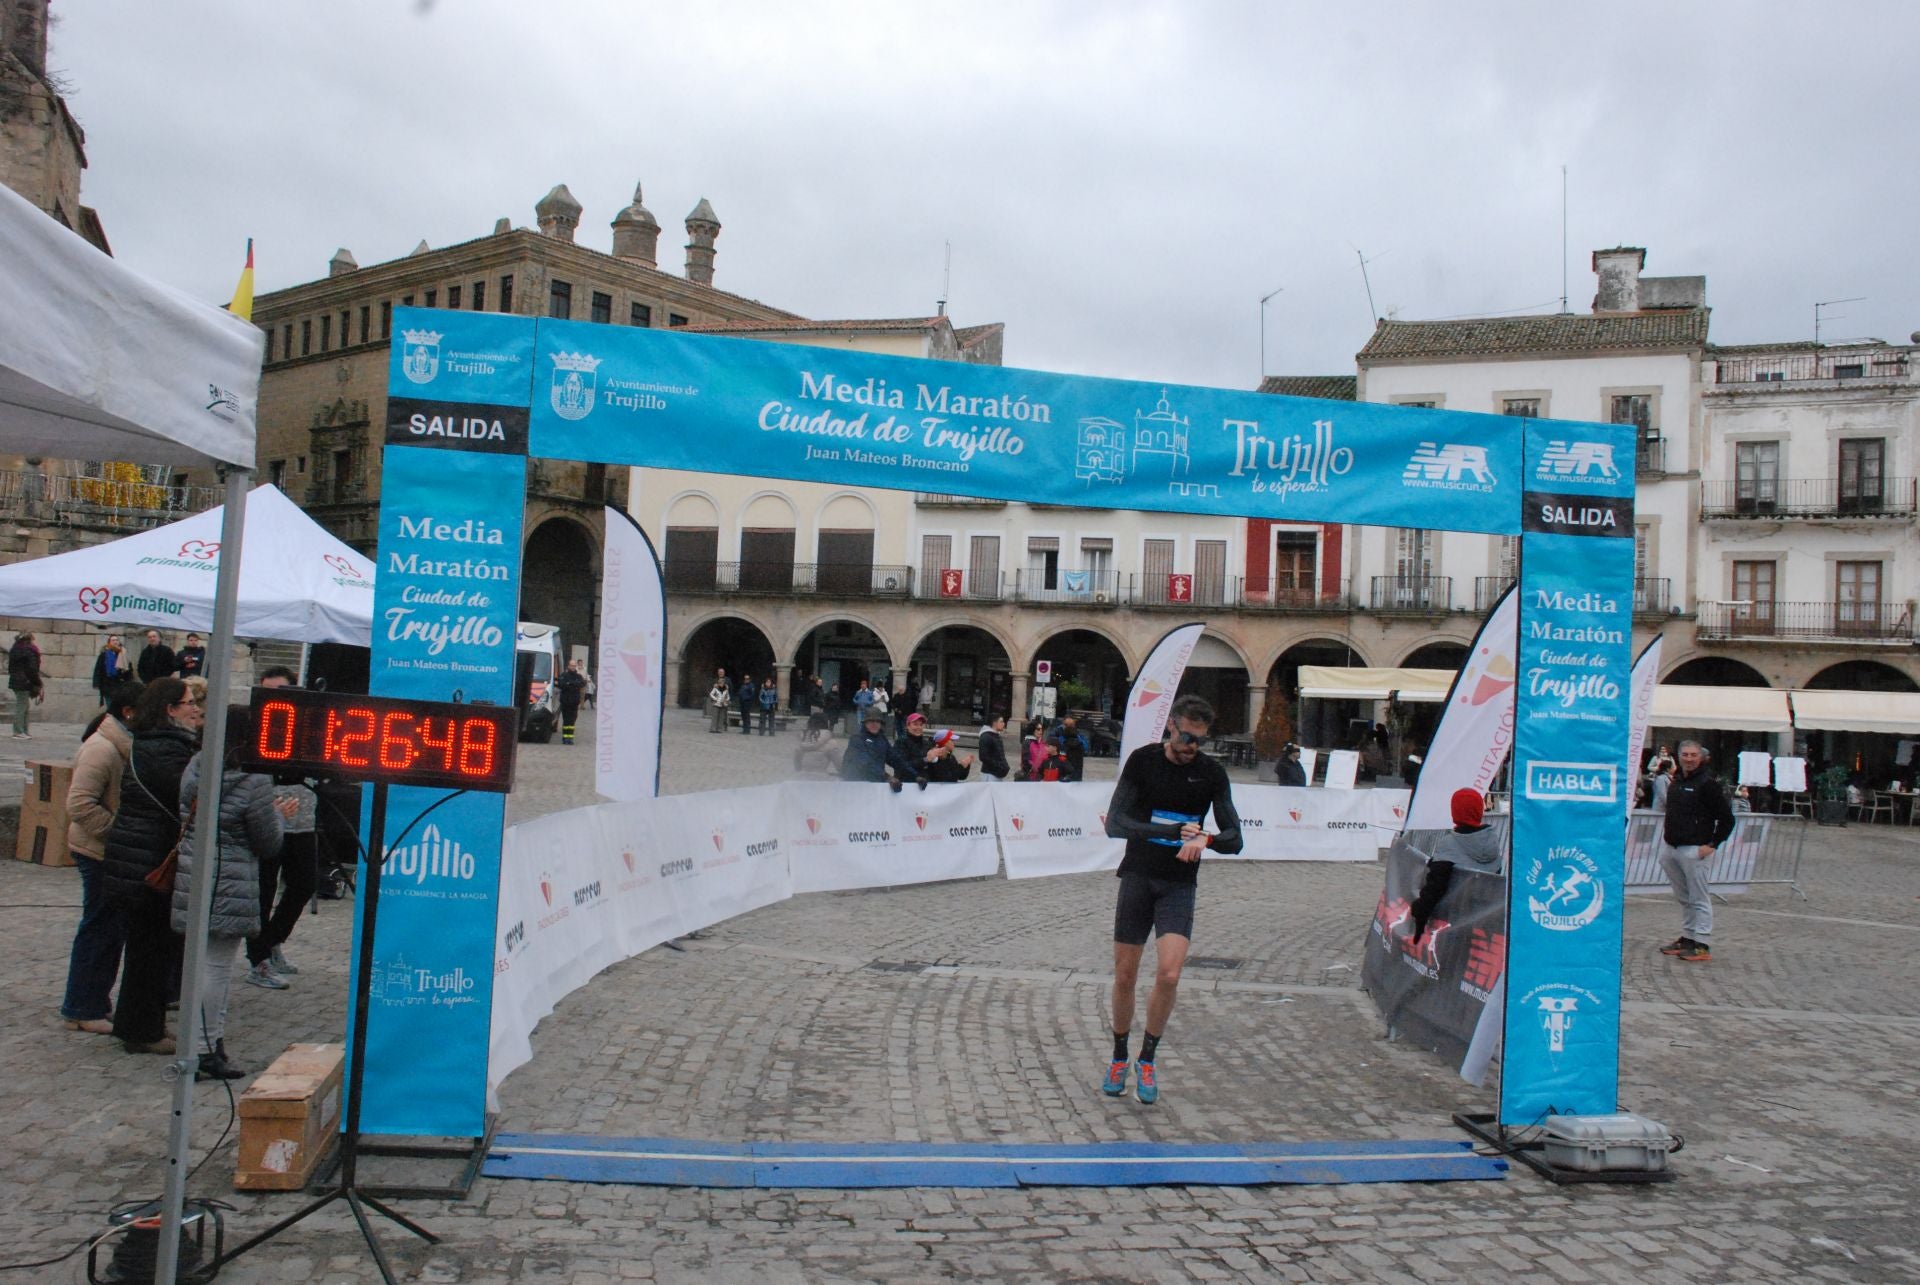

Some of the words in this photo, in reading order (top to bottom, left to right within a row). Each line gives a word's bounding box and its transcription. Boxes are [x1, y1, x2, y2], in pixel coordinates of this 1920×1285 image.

[445, 360, 496, 376] Trujillo
[605, 377, 682, 396] Ayuntamiento
[684, 384, 699, 396] de
[799, 370, 904, 410] Media
[914, 383, 1052, 423] Maratón
[604, 391, 667, 411] Trujillo
[409, 414, 505, 441] SALIDA
[758, 401, 868, 438] Ciudad
[873, 415, 914, 443] de
[920, 417, 1025, 461] Trujillo
[804, 445, 840, 461] Juan
[844, 447, 897, 467] Mateos
[902, 453, 970, 473] Broncano
[1223, 418, 1354, 486] Trujillo
[1251, 472, 1266, 493] te
[1402, 478, 1494, 493] www.musicrun.es
[1535, 471, 1617, 485] www.musicrun.es
[1541, 505, 1616, 527] SALIDA
[397, 515, 504, 545] Media
[135, 556, 221, 571] primaflor
[388, 551, 510, 581] Maratón
[112, 594, 184, 616] primaflor
[402, 585, 466, 606] Ciudad
[467, 591, 491, 608] de
[1535, 589, 1617, 614] Media
[385, 607, 503, 656] Trujillo
[1530, 621, 1624, 644] Maratón
[388, 657, 410, 669] Juan
[413, 659, 449, 671] Mateos
[451, 661, 498, 673] Broncano
[1540, 649, 1586, 666] Ciudad
[1588, 653, 1608, 668] de
[1527, 667, 1620, 707] Trujillo
[1538, 773, 1603, 791] HABLA
[1526, 857, 1542, 885] Club
[1547, 845, 1598, 872] Atletismo
[1533, 910, 1587, 928] TRUJILLO
[414, 967, 474, 993] Trujillo
[1543, 1015, 1551, 1029] A
[1563, 1015, 1571, 1029] J
[1553, 1030, 1561, 1044] S
